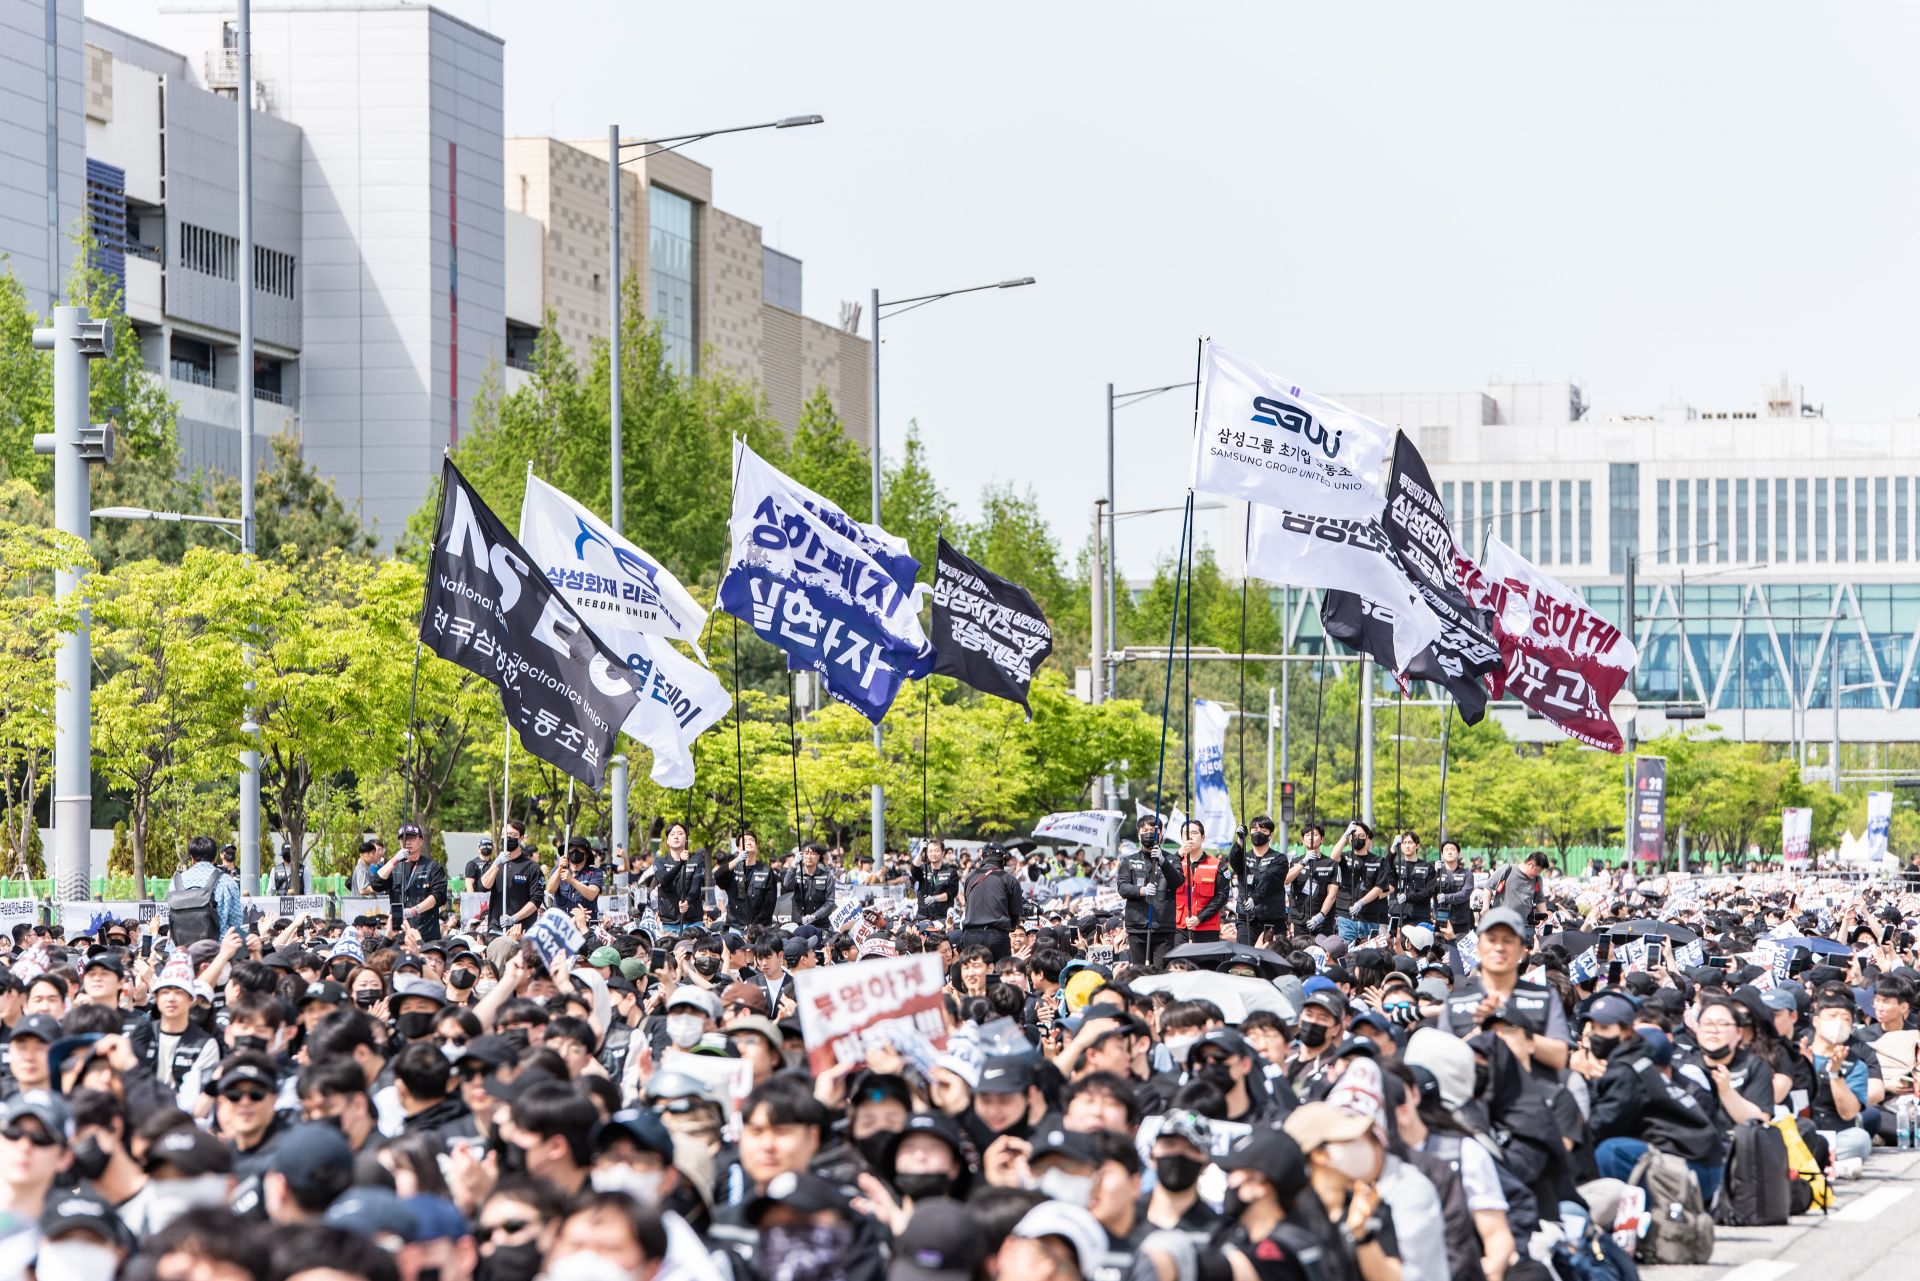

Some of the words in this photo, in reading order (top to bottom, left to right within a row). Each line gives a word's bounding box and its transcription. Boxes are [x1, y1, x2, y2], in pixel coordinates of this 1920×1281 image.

[1217, 428, 1275, 454] 삼성그룹
[1278, 442, 1311, 465] 초기업
[1210, 447, 1263, 467] SAMSUNG
[1265, 461, 1298, 475] GROUP
[1299, 470, 1331, 487] UNITED
[1334, 481, 1365, 491] UNIO
[440, 574, 493, 612] National
[547, 567, 617, 597] 삼성화재
[577, 598, 621, 613] REBORN
[626, 606, 658, 621] UNION
[749, 577, 891, 689] 실현하자
[434, 605, 600, 768] 전국삼성전동조합
[513, 652, 582, 704] Electronics
[813, 962, 926, 1022] 투명하게
